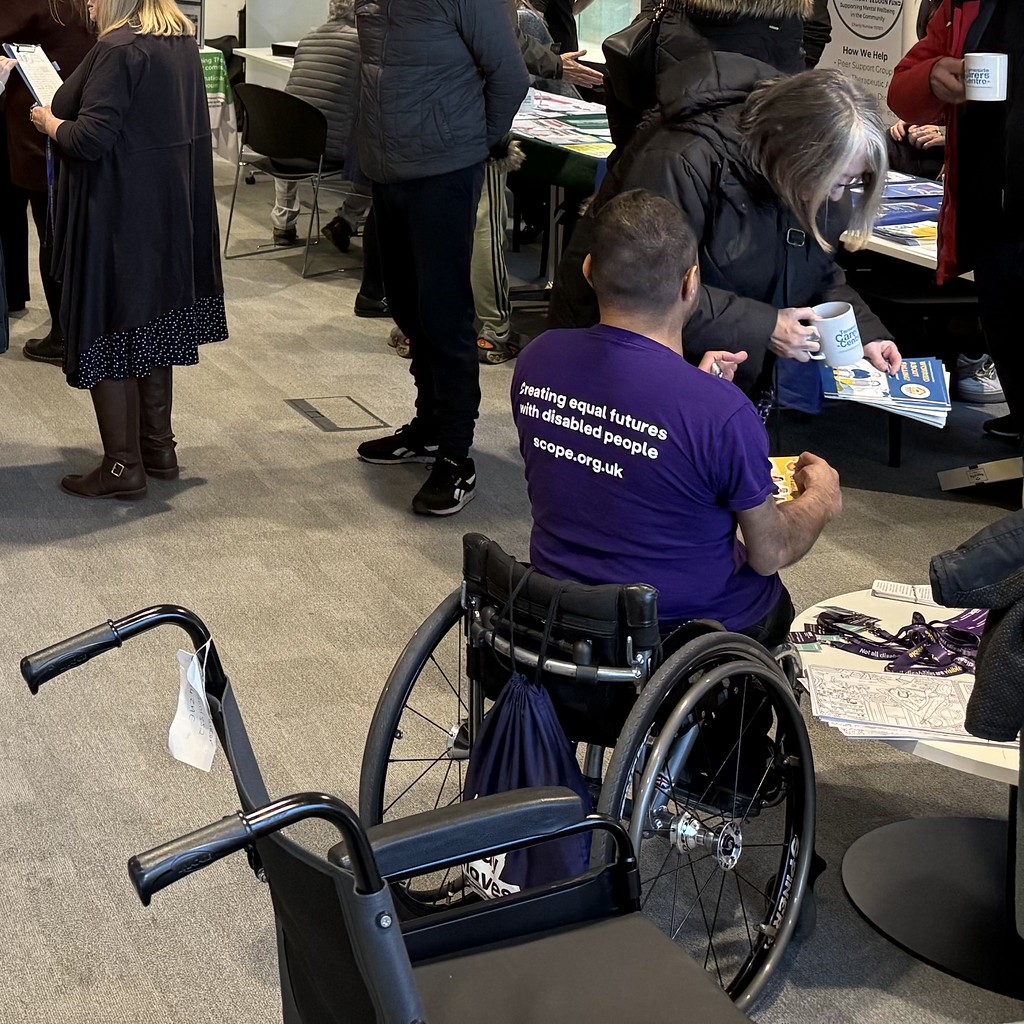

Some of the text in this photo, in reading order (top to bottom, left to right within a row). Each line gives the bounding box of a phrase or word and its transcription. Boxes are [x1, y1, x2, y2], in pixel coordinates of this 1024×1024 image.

[840, 2, 862, 11] Supporting
[863, 13, 885, 23] Community
[842, 46, 888, 62] How We Help
[837, 58, 851, 68] Peer
[851, 61, 875, 73] Support
[519, 382, 668, 441] Creating equal futures
[519, 402, 659, 460] with disabled people
[533, 436, 624, 479] scope.org.uk
[859, 647, 870, 655] Not
[944, 664, 963, 676] visible
[763, 834, 800, 950] SPINER
